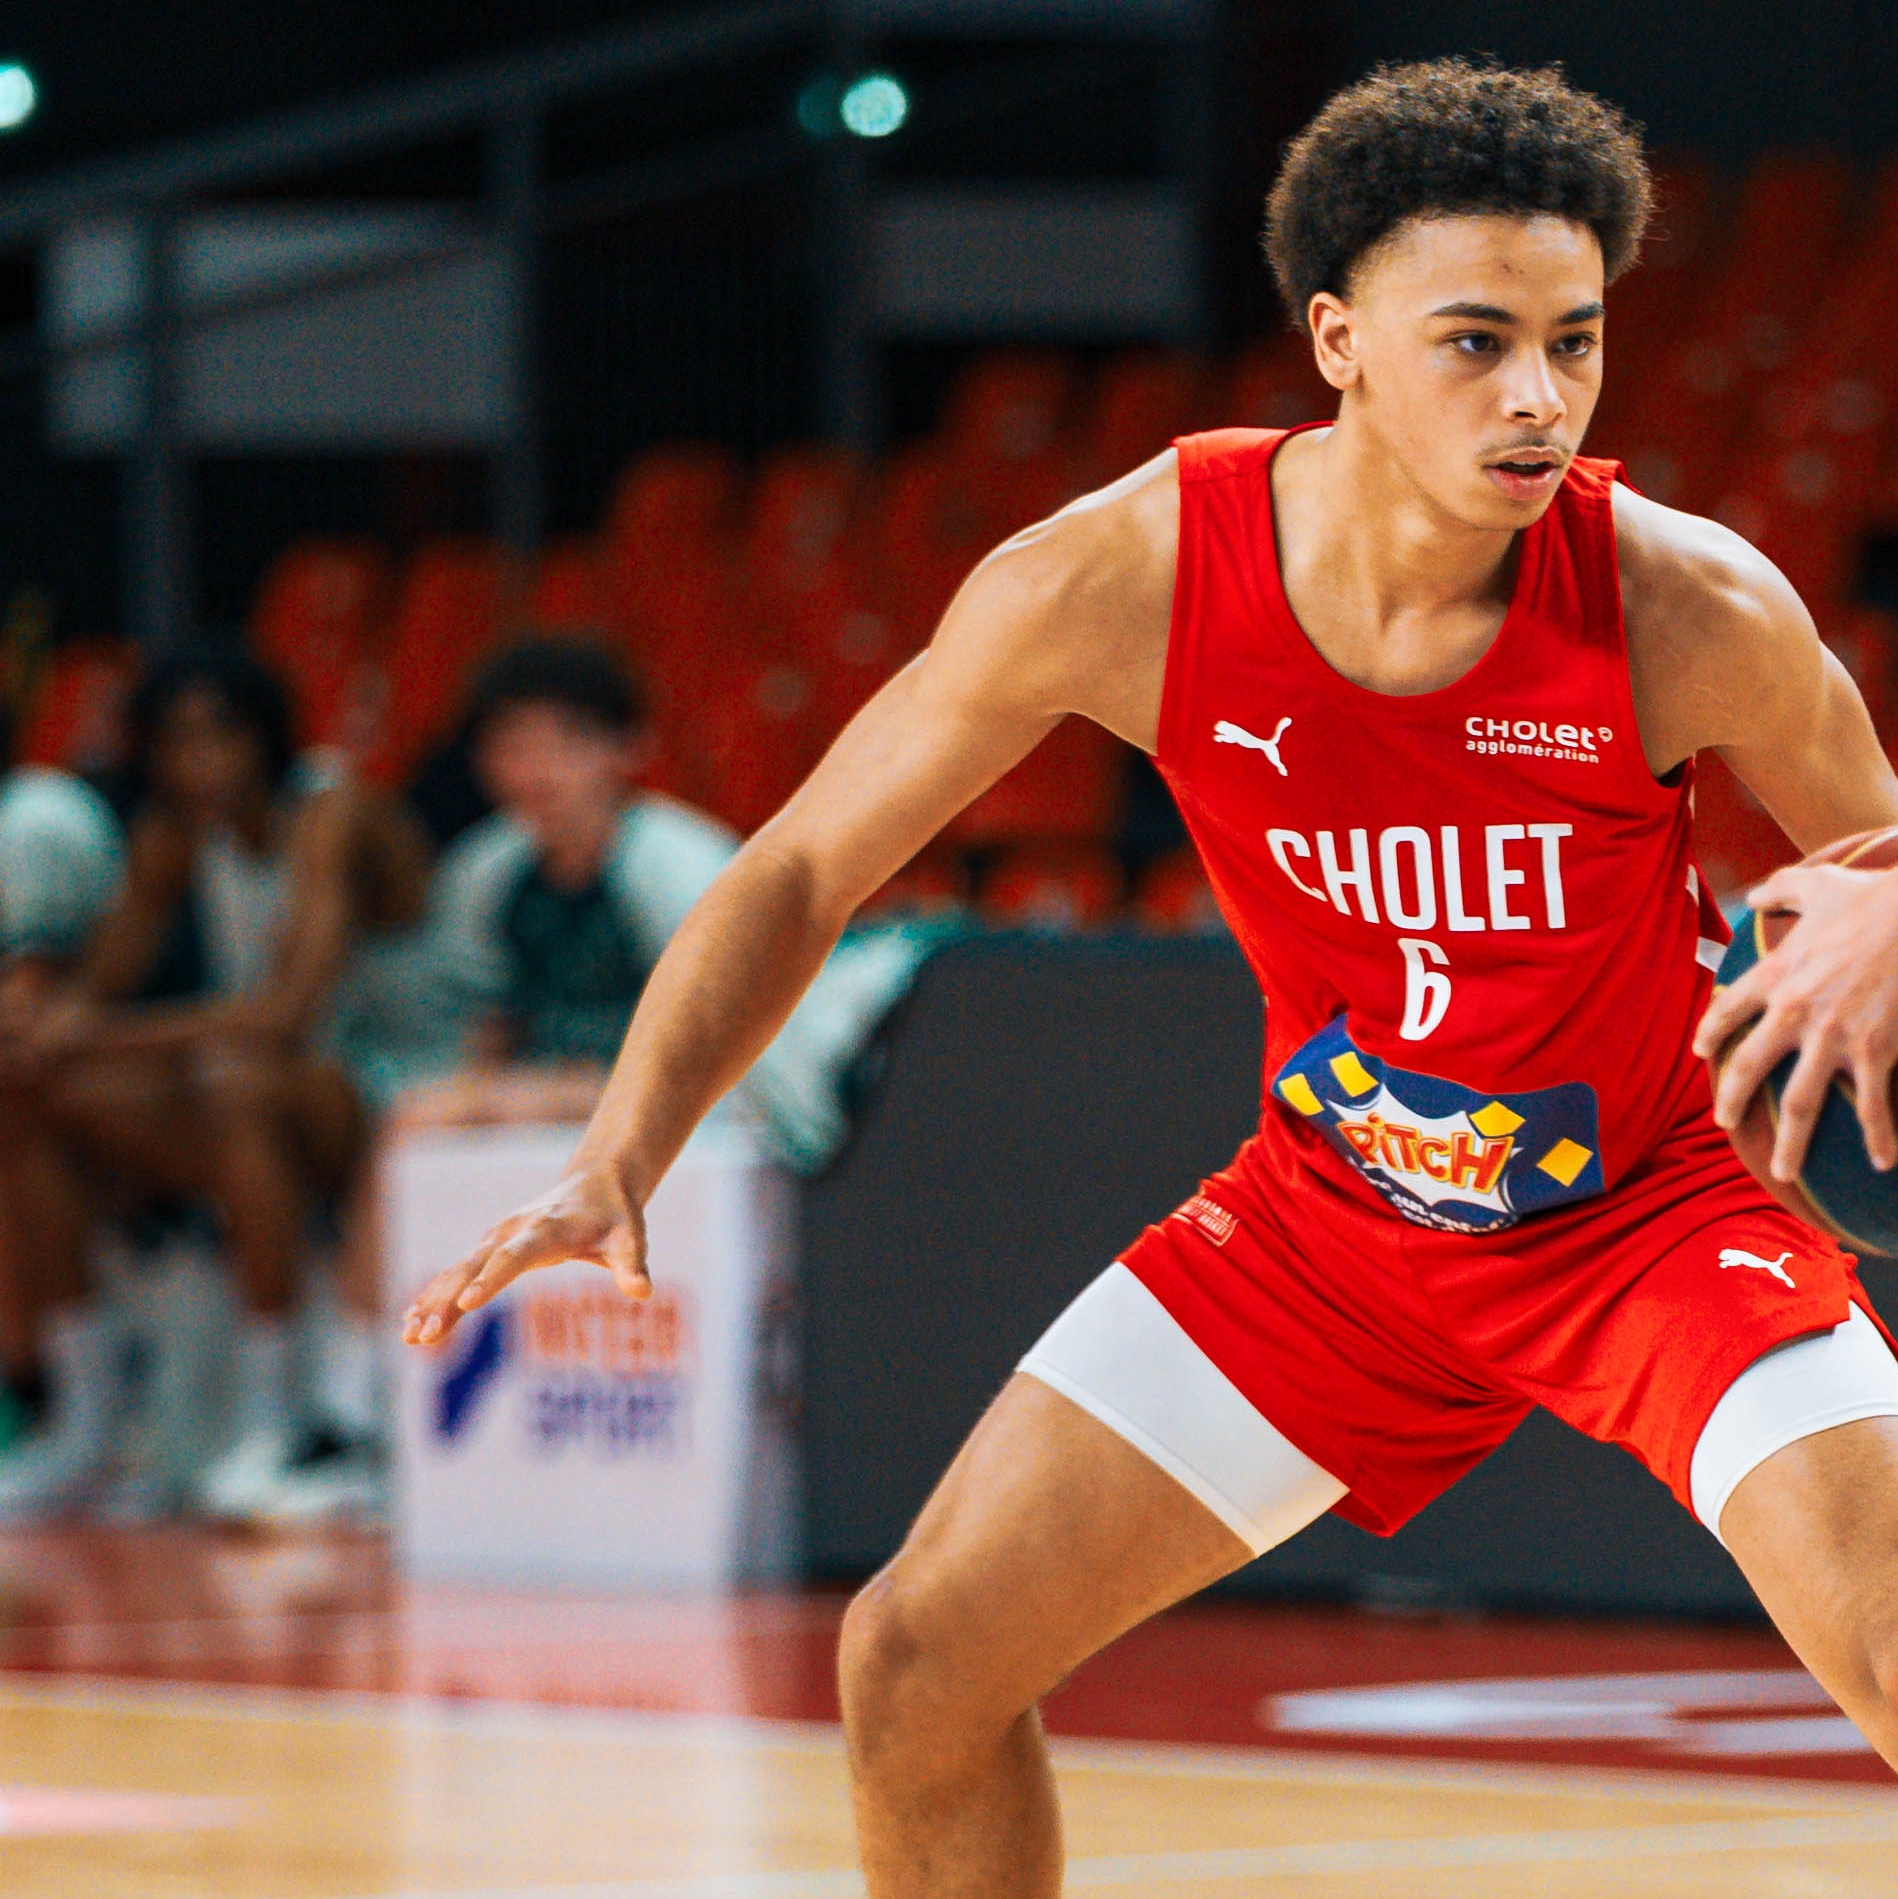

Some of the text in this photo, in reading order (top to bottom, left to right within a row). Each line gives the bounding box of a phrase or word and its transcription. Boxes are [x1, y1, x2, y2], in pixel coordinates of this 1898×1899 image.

[1465, 739, 1600, 764] agglomération
[1265, 823, 1572, 932] CHOLET
[1398, 937, 1452, 1041] 6
